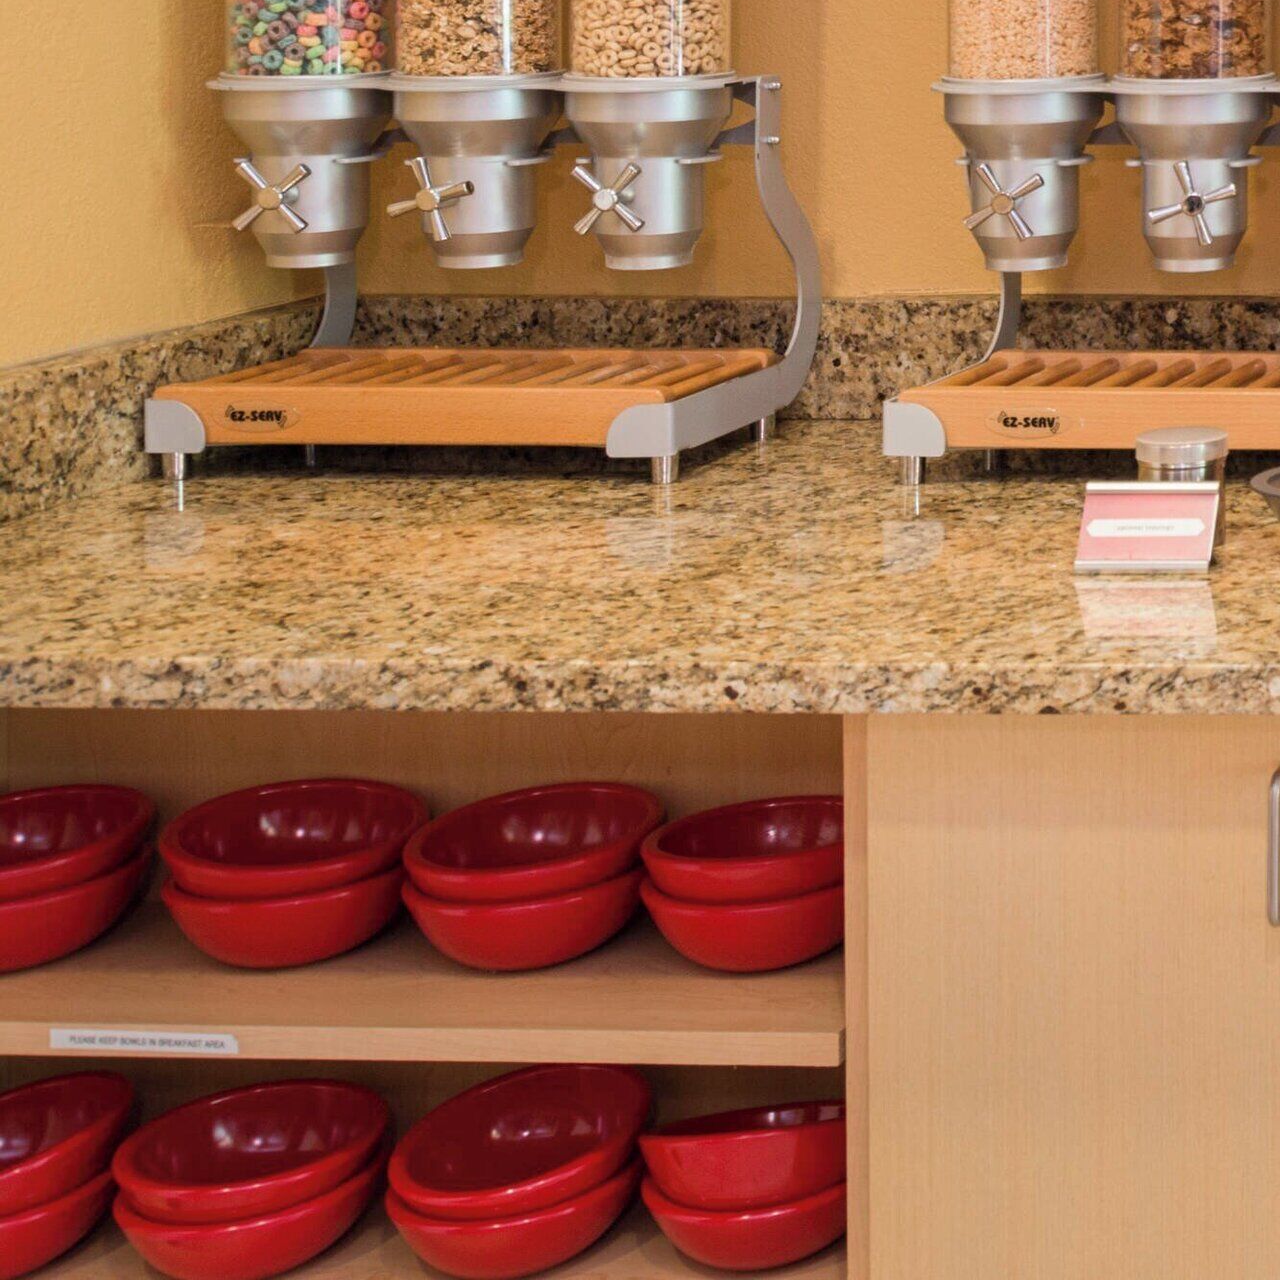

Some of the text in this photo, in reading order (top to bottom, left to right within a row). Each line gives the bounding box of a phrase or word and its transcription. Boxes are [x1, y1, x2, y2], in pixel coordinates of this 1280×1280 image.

[230, 410, 283, 422] EZ-SERV
[1003, 417, 1056, 428] EZ-SERV
[69, 1035, 97, 1044] PLEASE
[99, 1037, 117, 1045] KEEP
[120, 1038, 146, 1046] BOWLS
[158, 1039, 202, 1048] BREAKFAST
[204, 1041, 226, 1049] AREA
